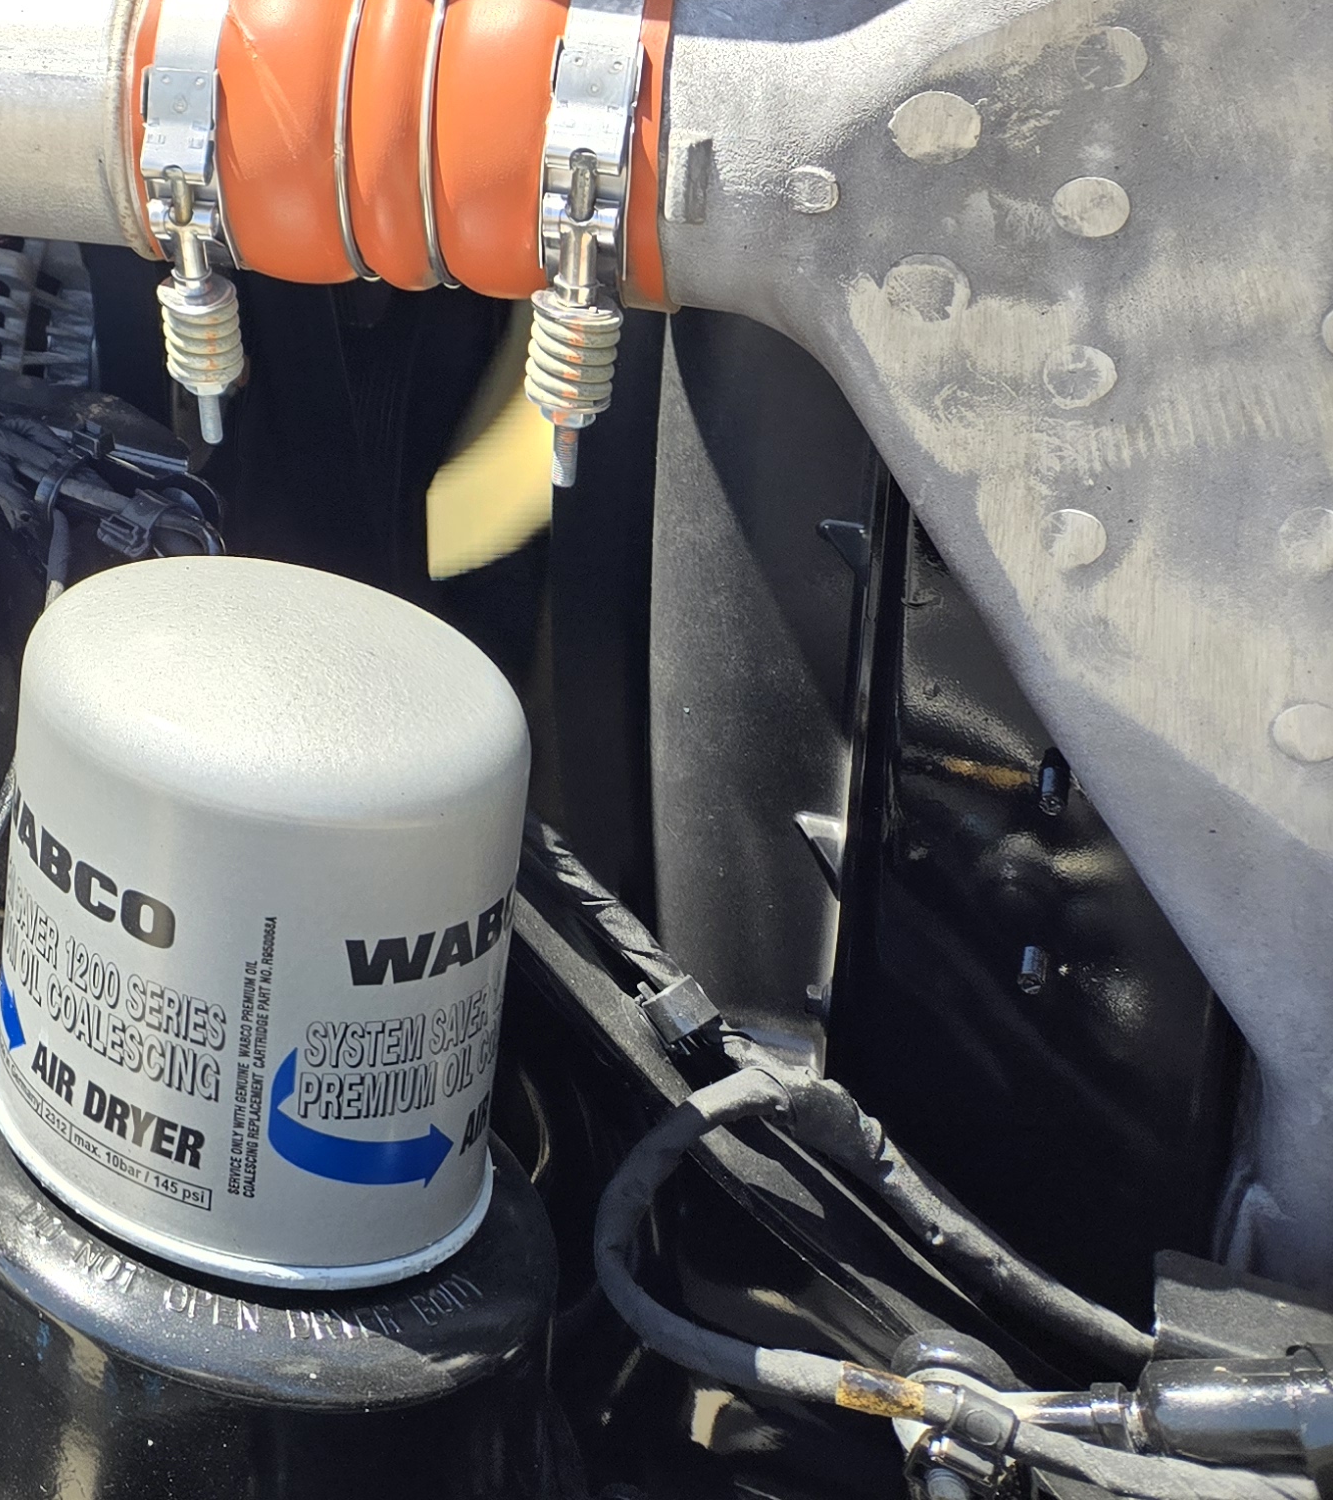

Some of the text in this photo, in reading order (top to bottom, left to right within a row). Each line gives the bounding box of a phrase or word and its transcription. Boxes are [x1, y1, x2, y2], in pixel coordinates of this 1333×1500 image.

[12, 786, 176, 950] ABCO
[65, 934, 121, 1009] 1200
[126, 973, 227, 1051] SERIES
[257, 985, 272, 1011] PART
[260, 966, 273, 984] NO.
[18, 939, 43, 1008] OIL
[46, 973, 222, 1103] COALESCING
[253, 1013, 270, 1069] CARTRIDGE
[305, 1012, 425, 1069] SYSTEM
[429, 982, 490, 1055] SAVER
[31, 1040, 206, 1170] AIR DRYER
[227, 959, 258, 1196] SERVICE ONLY WITH GENUINE WABCO PREMIUM OIL
[247, 1072, 265, 1140] REPLACEMENT
[297, 1060, 439, 1120] PREMIUM
[442, 1044, 473, 1098] OIL
[45, 1107, 69, 1136] 2312
[459, 1090, 491, 1156] AIR
[73, 1132, 205, 1205] max. 10bar / 145 psi
[242, 1139, 260, 1198] COALESCING
[71, 1239, 139, 1295] NOT
[163, 1283, 260, 1334] OPEN
[285, 1303, 401, 1339] DRYER
[410, 1273, 483, 1327] BODY
